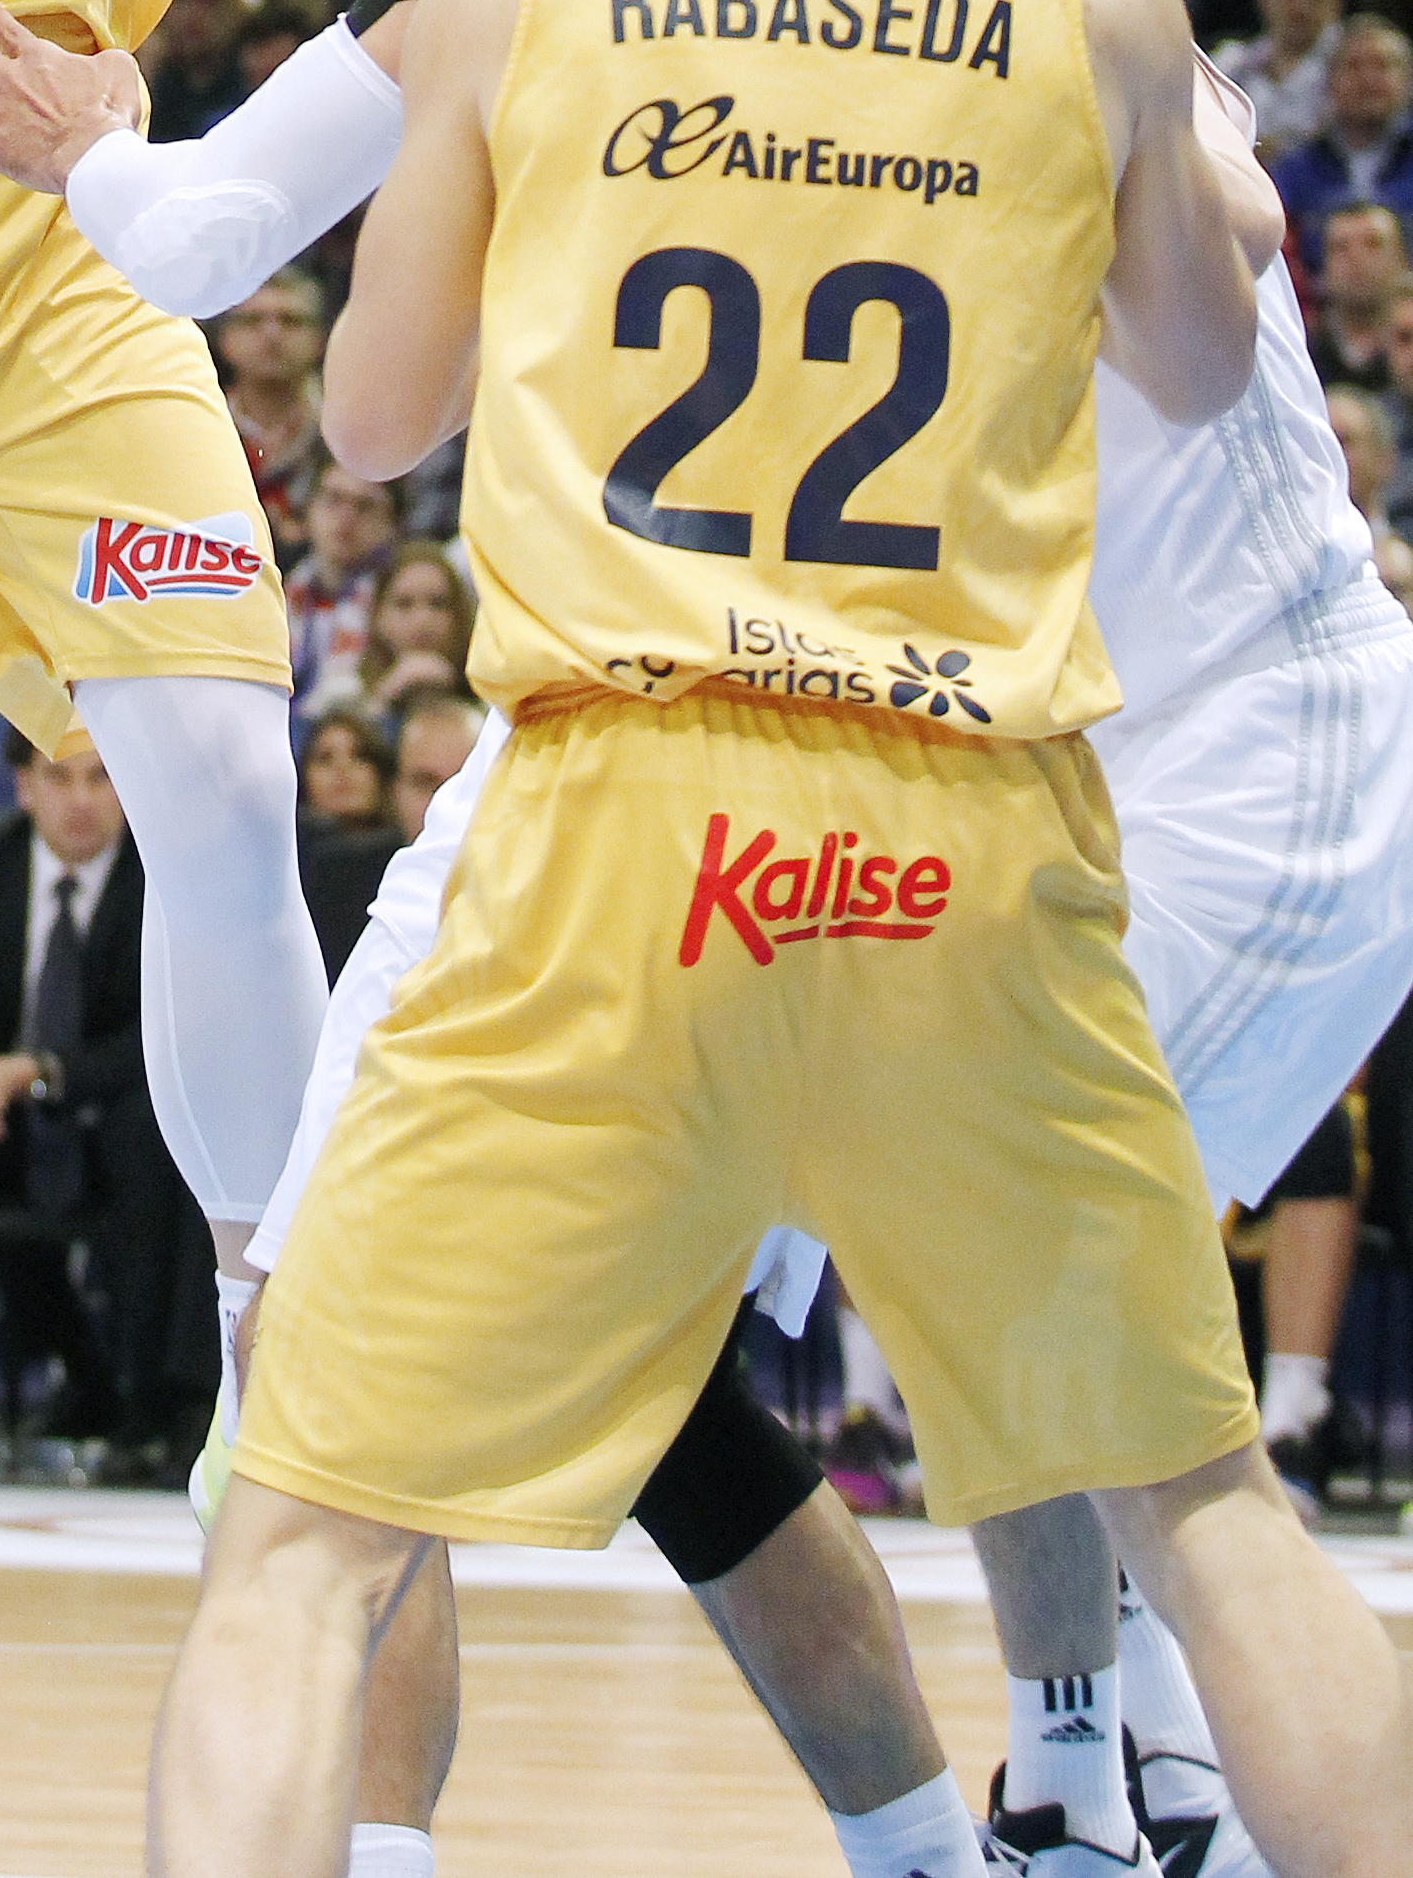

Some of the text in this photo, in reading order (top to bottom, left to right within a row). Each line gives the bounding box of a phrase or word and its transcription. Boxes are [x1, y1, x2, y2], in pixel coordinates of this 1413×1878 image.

[602, 246, 952, 572] 22
[91, 517, 263, 604] Kalise
[678, 813, 952, 968] Kalise
